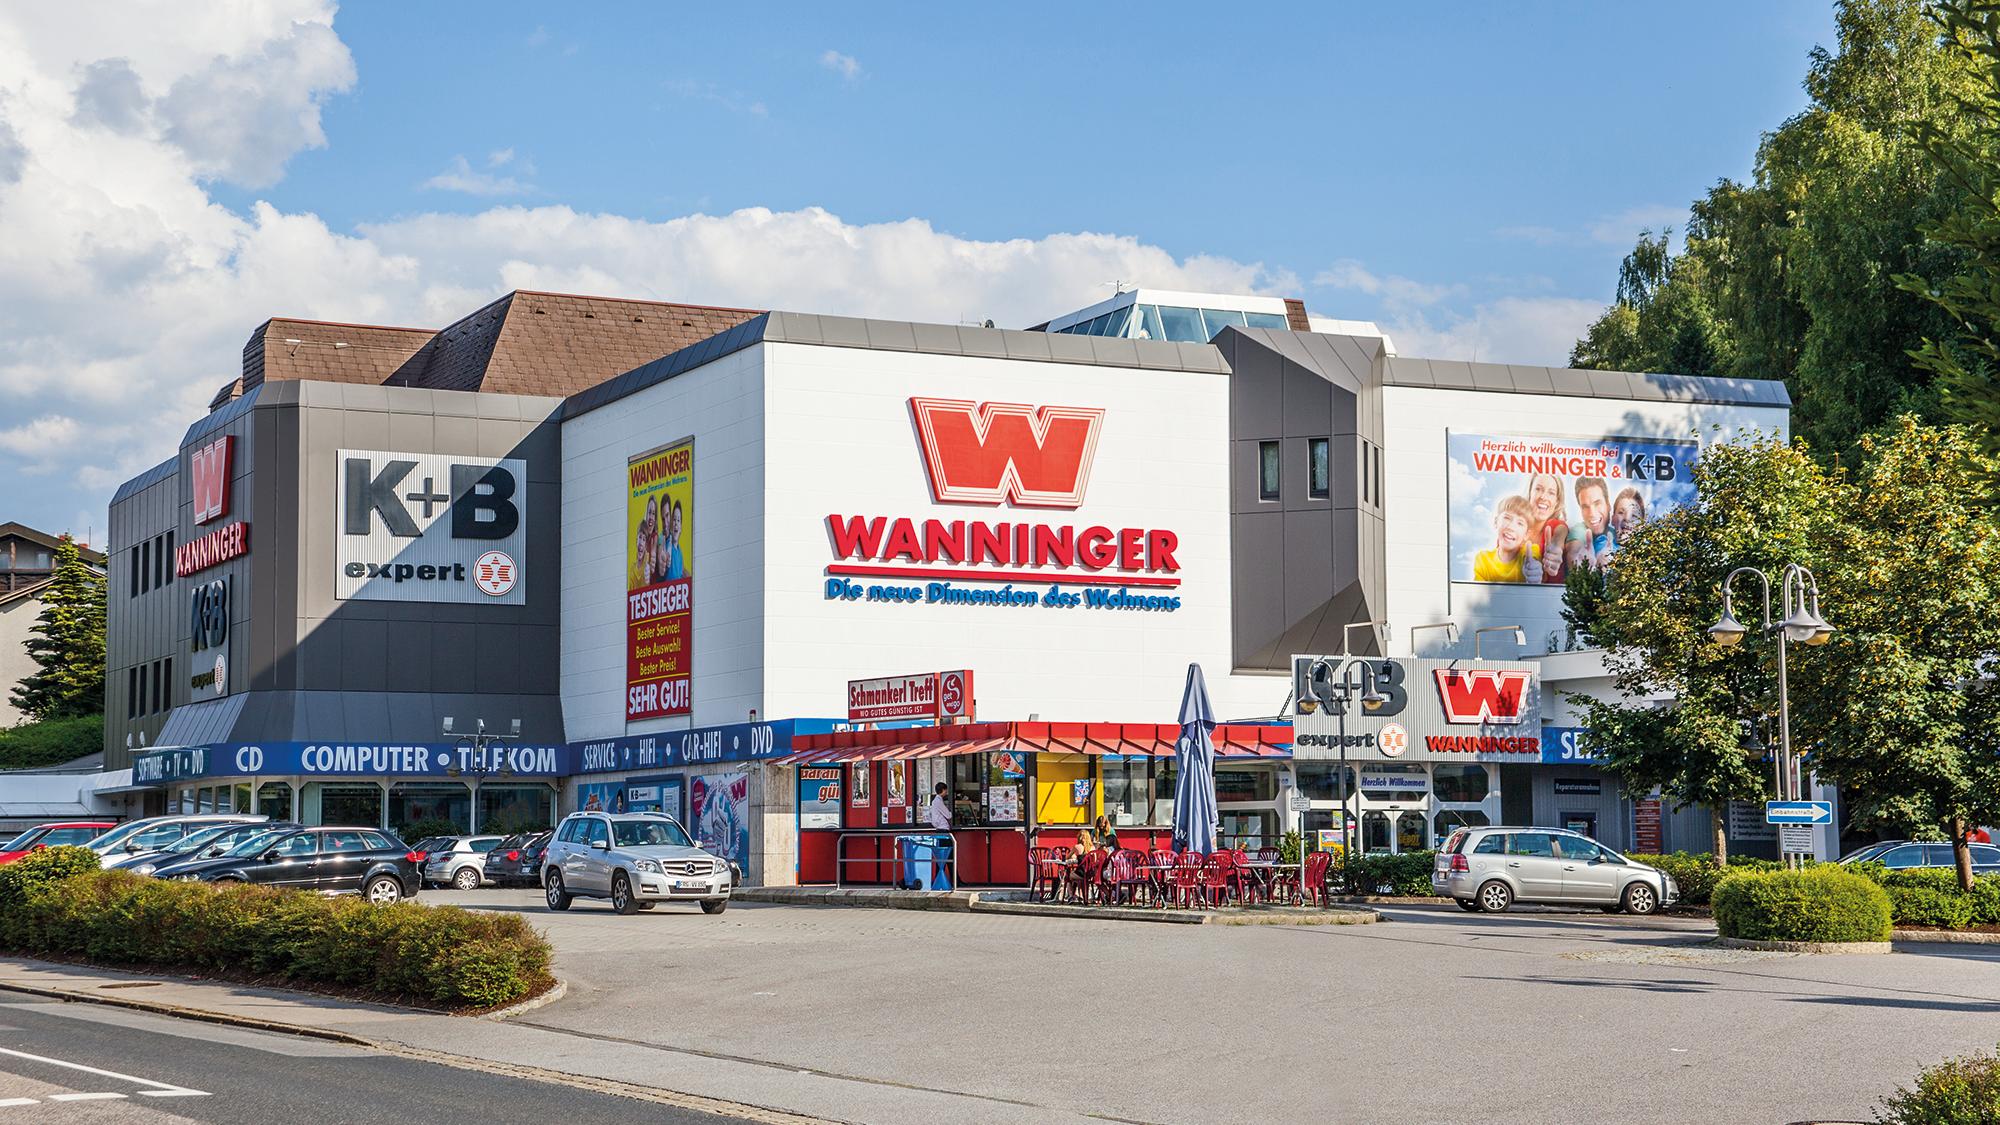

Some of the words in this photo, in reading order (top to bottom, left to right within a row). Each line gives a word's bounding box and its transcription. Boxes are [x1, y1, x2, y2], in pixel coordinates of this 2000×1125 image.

[906, 397, 1105, 511] W
[1482, 440, 1526, 453] Herzlich
[1530, 443, 1598, 457] willkommen
[1601, 446, 1619, 458] bei
[192, 435, 235, 526] W
[630, 450, 690, 488] WANNINGER
[1473, 453, 1607, 478] WANNINGER
[1611, 466, 1621, 478] &
[1625, 454, 1676, 481] K+B
[345, 458, 519, 540] K+B
[175, 522, 248, 577] WANNINGER
[824, 514, 1181, 571] WANNINGER
[345, 562, 465, 583] expert
[630, 583, 689, 620] TESTSIEGER
[826, 578, 863, 600] Die
[867, 584, 923, 602] neue
[925, 582, 1039, 607] Dimension
[1042, 585, 1081, 607] des
[1084, 587, 1181, 611] Wohnens
[191, 579, 227, 652] K+B
[637, 628, 655, 640] Bester
[657, 620, 680, 637] Service!
[636, 645, 651, 658] Beste
[653, 638, 681, 657] Auswahl!
[640, 663, 658, 676] Bester
[660, 657, 676, 672] Preis!
[629, 683, 658, 715] SEHR
[661, 680, 689, 710] GUT!
[850, 680, 906, 707] Schmankerl
[909, 677, 934, 702] Treff
[1296, 658, 1408, 717] K+B
[1432, 669, 1532, 724] W
[860, 709, 869, 717] WO
[870, 708, 887, 716] GUTES
[889, 706, 913, 715] GÜNSTIG
[584, 742, 615, 770] SERVICE
[639, 737, 656, 764] HIFI
[682, 731, 722, 761] CAR-HIFI
[751, 725, 773, 755] DVD
[1297, 733, 1375, 749] expert
[1426, 735, 1540, 754] WANNINGER
[138, 755, 163, 781] SOFTWARE
[173, 752, 182, 777] TV
[192, 749, 204, 775] DVD
[235, 746, 264, 772] CD
[301, 746, 428, 772] COMPUTER
[458, 747, 557, 773] TELEKOM
[1361, 776, 1387, 787] Herzlich
[1388, 777, 1426, 787] Willkommen
